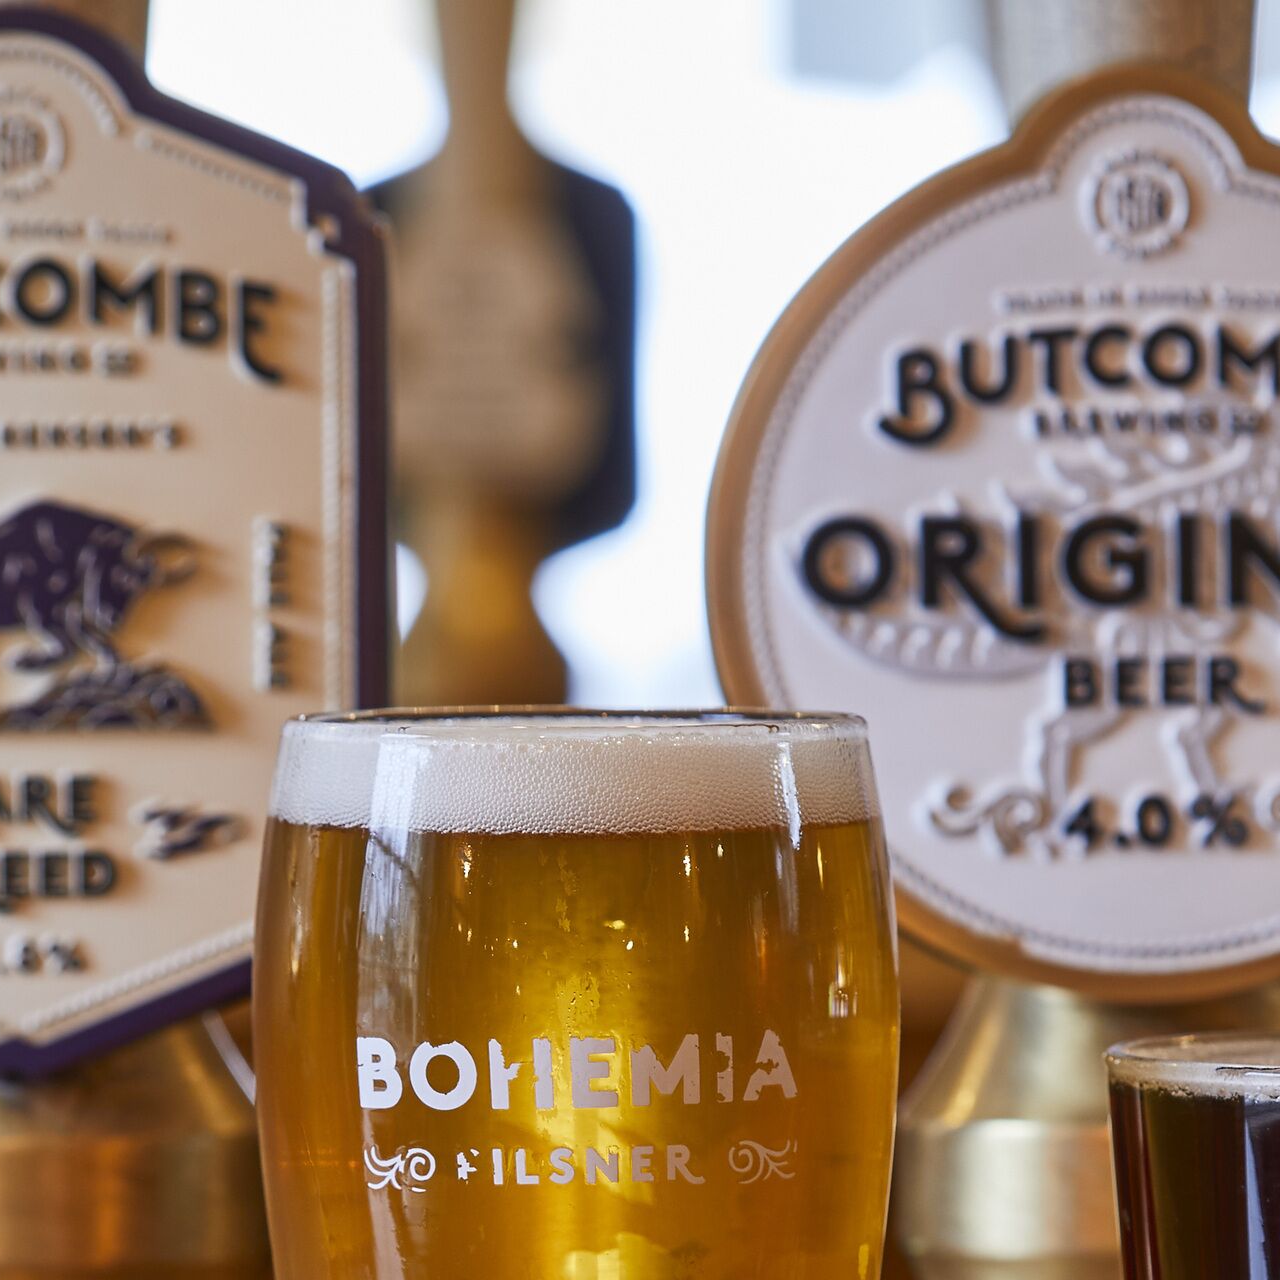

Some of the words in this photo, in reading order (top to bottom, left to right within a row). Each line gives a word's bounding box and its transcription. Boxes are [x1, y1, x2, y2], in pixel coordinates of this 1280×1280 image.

[1062, 654, 1267, 716] BEER
[1064, 793, 1250, 849] 4.0%
[356, 1028, 799, 1112] BOHEMIA
